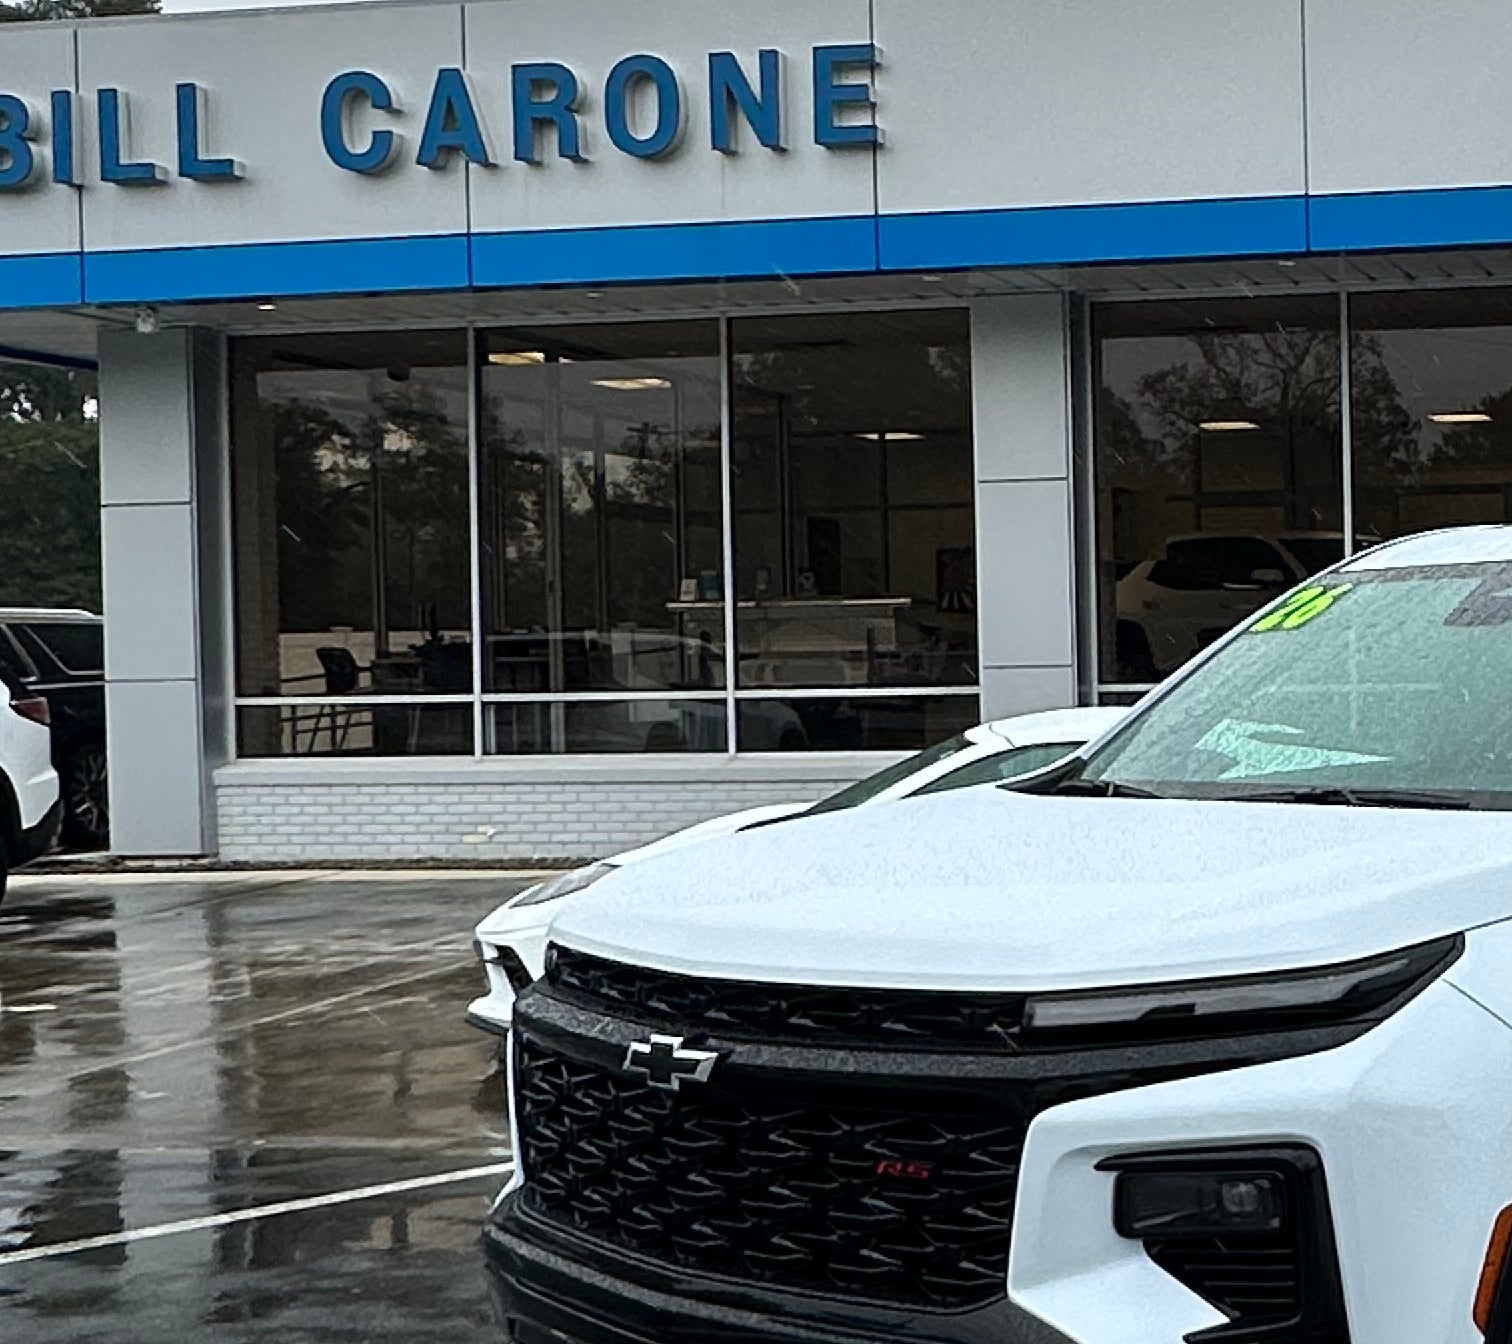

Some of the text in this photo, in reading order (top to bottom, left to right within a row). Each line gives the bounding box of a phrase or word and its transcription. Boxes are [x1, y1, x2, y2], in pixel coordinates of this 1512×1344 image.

[0, 43, 882, 188] BILL CARONE
[876, 1159, 932, 1178] RS
